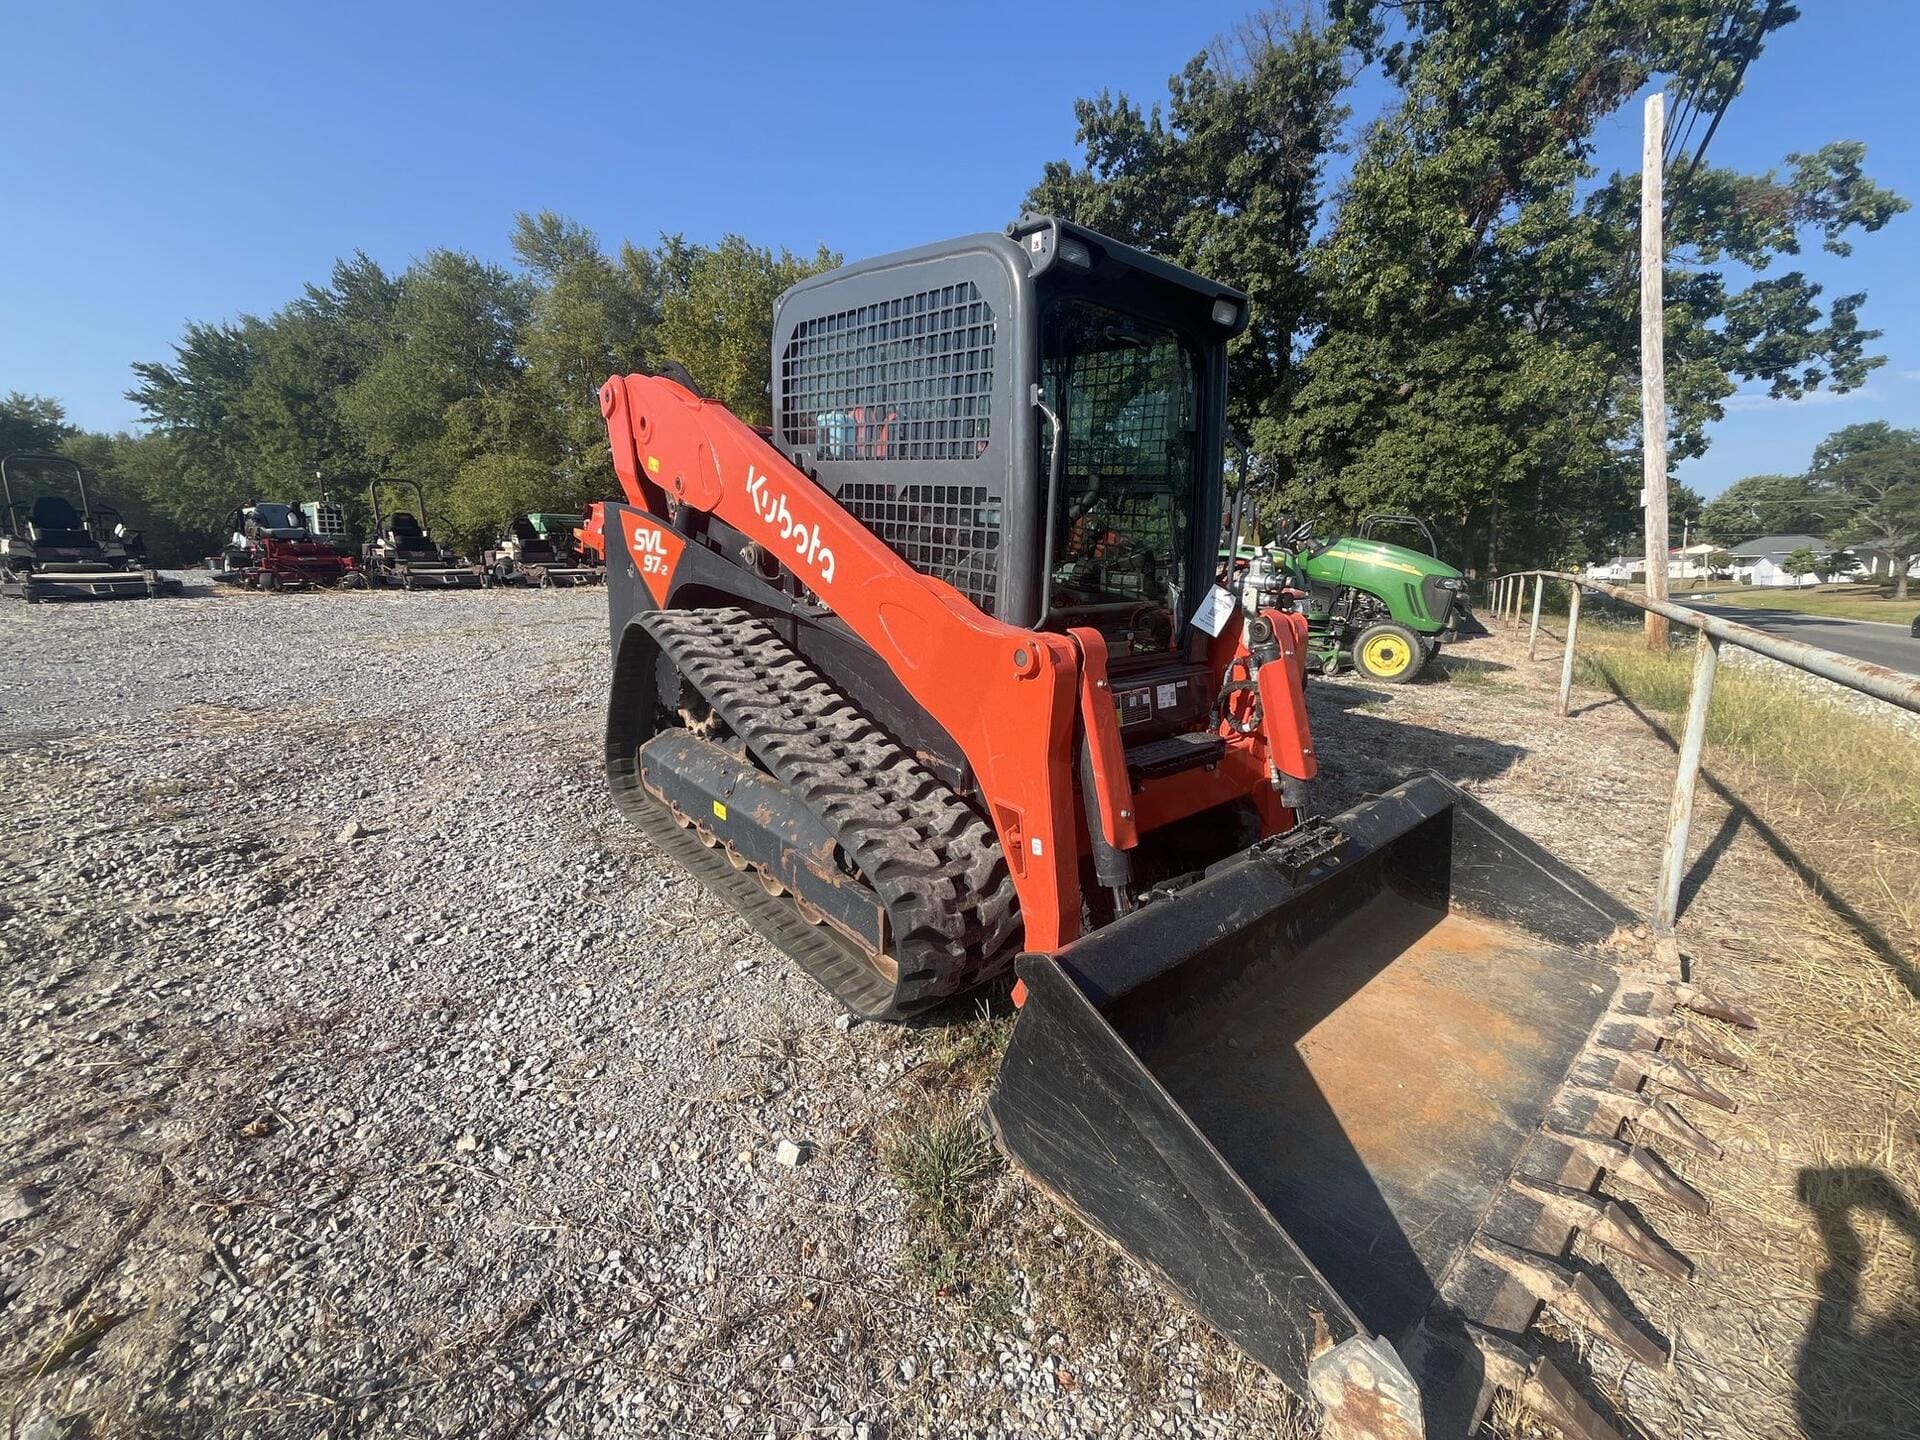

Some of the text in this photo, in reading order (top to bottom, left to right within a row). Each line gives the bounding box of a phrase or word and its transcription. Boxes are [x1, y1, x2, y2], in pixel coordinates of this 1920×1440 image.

[746, 464, 835, 584] Kubota
[633, 528, 668, 555] SVL
[643, 554, 668, 576] 97-2
